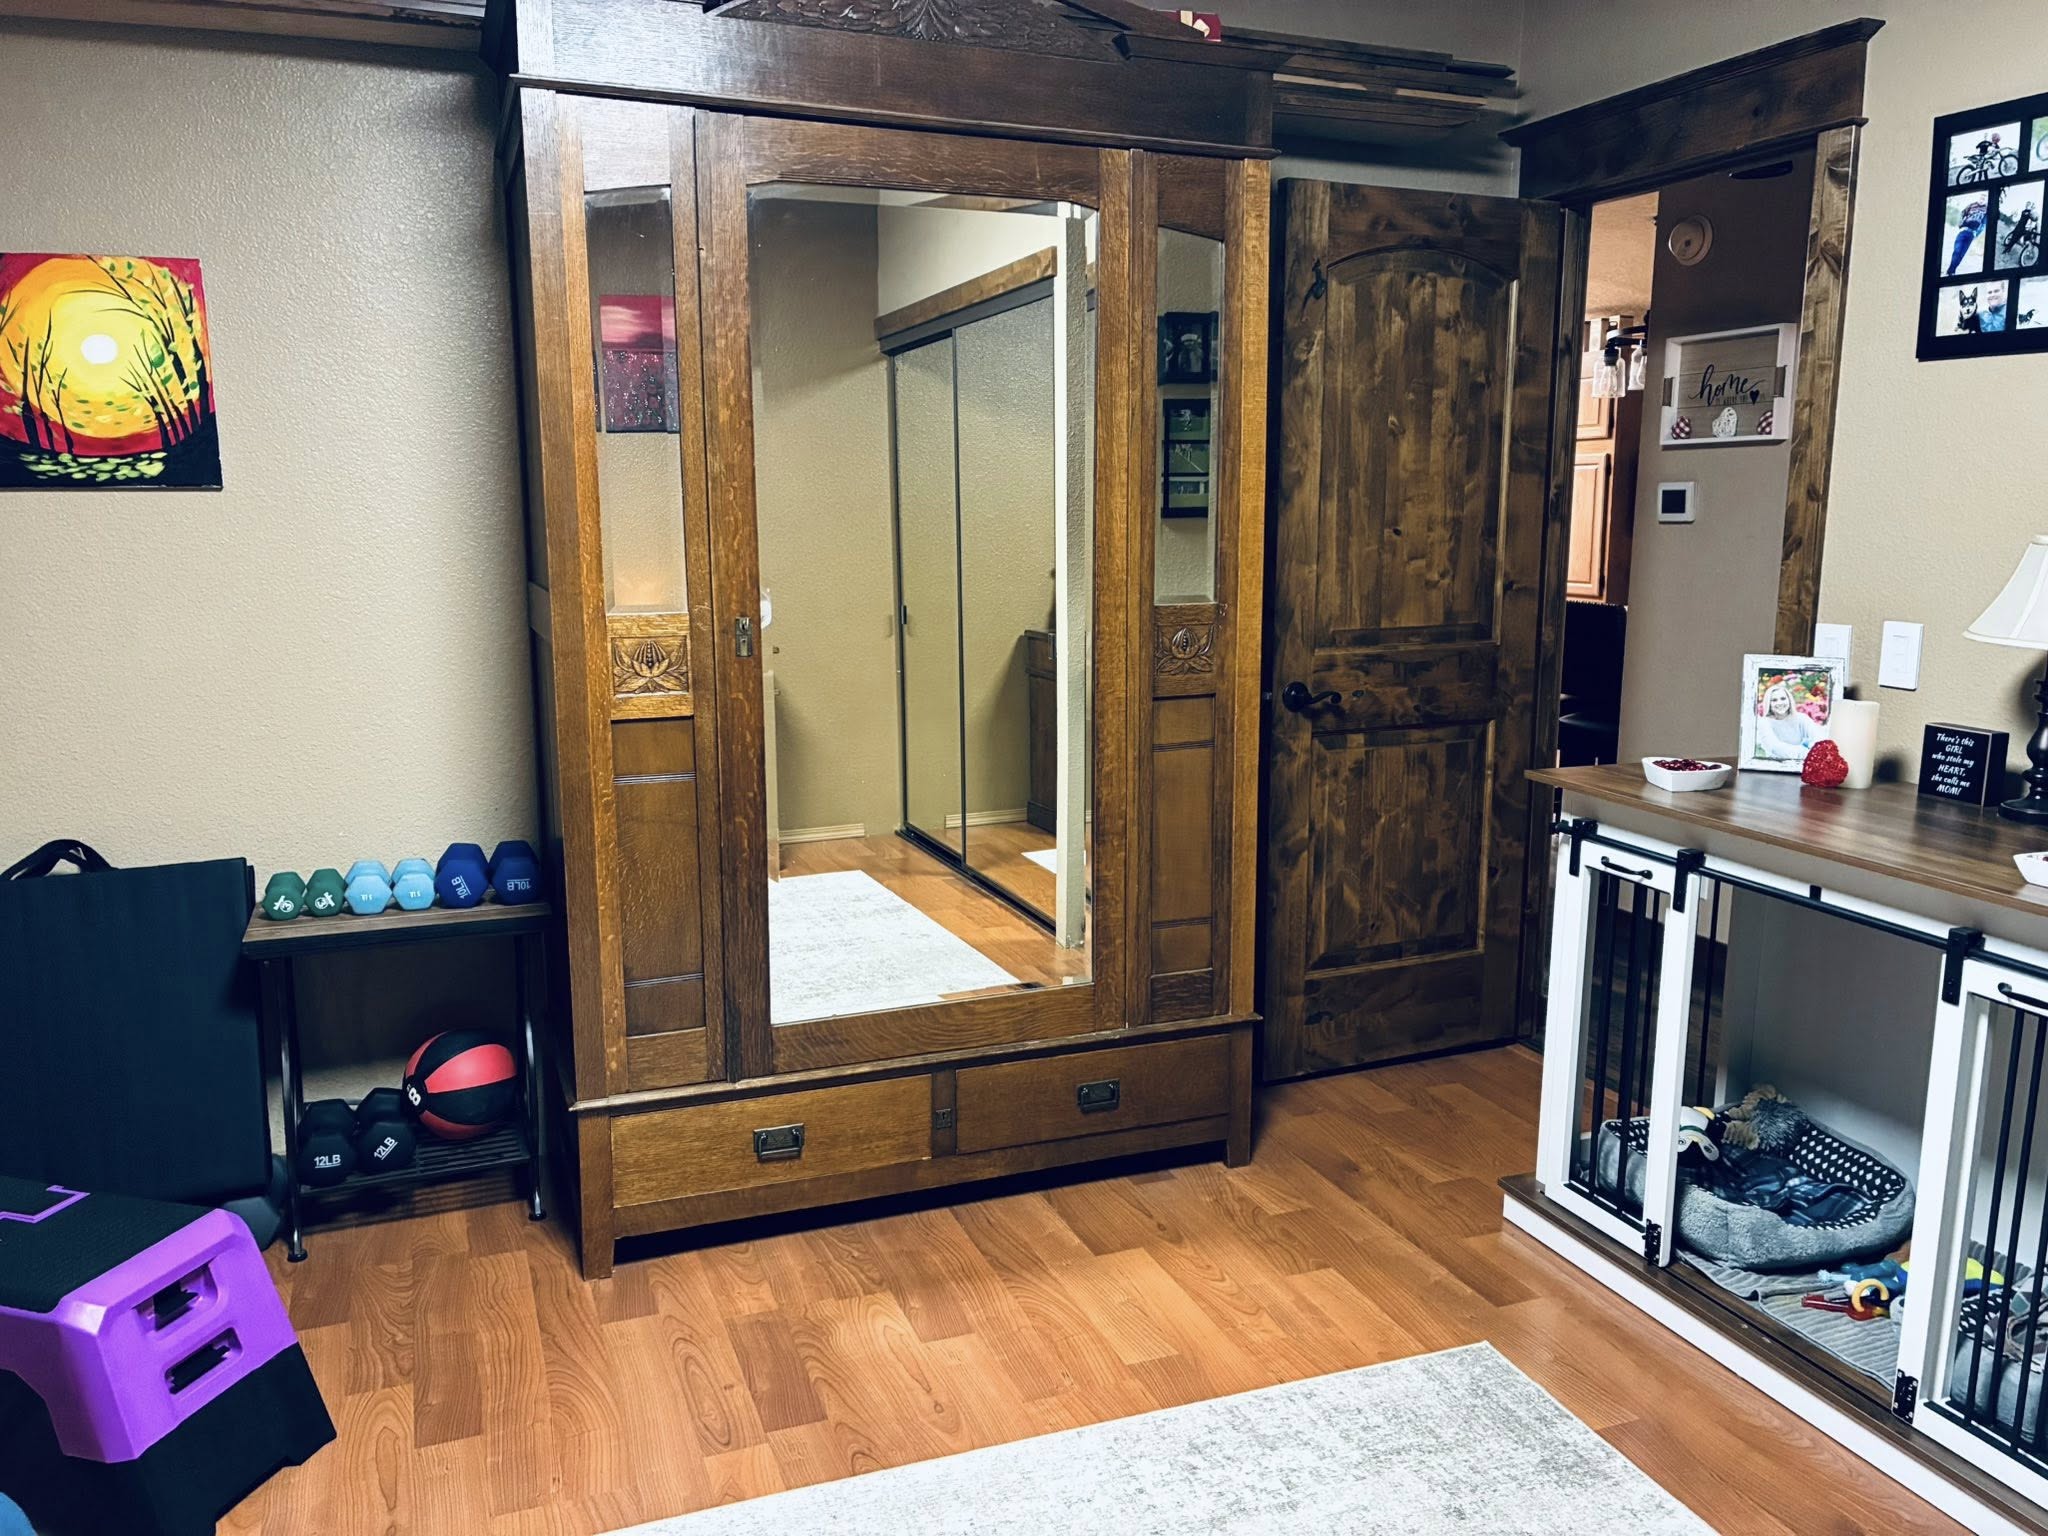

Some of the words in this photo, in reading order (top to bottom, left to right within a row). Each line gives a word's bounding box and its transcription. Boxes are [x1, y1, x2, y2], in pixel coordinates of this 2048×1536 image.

[1688, 364, 1766, 406] home
[1936, 733, 1960, 744] There's
[1961, 737, 1974, 747] this
[1945, 744, 1963, 754] GIRL
[1931, 752, 1945, 760] who
[1946, 755, 1962, 764] stole
[1963, 759, 1974, 768] my
[1938, 764, 1966, 776] HEART,
[1931, 773, 1943, 781] she
[1944, 776, 1959, 785] calls
[1936, 784, 1962, 796] MOM!
[451, 876, 468, 899] 10LB
[507, 880, 531, 891] 10LB
[408, 1087, 421, 1106] 8
[374, 1137, 396, 1159] 12LB
[314, 1154, 341, 1166] 12LB
